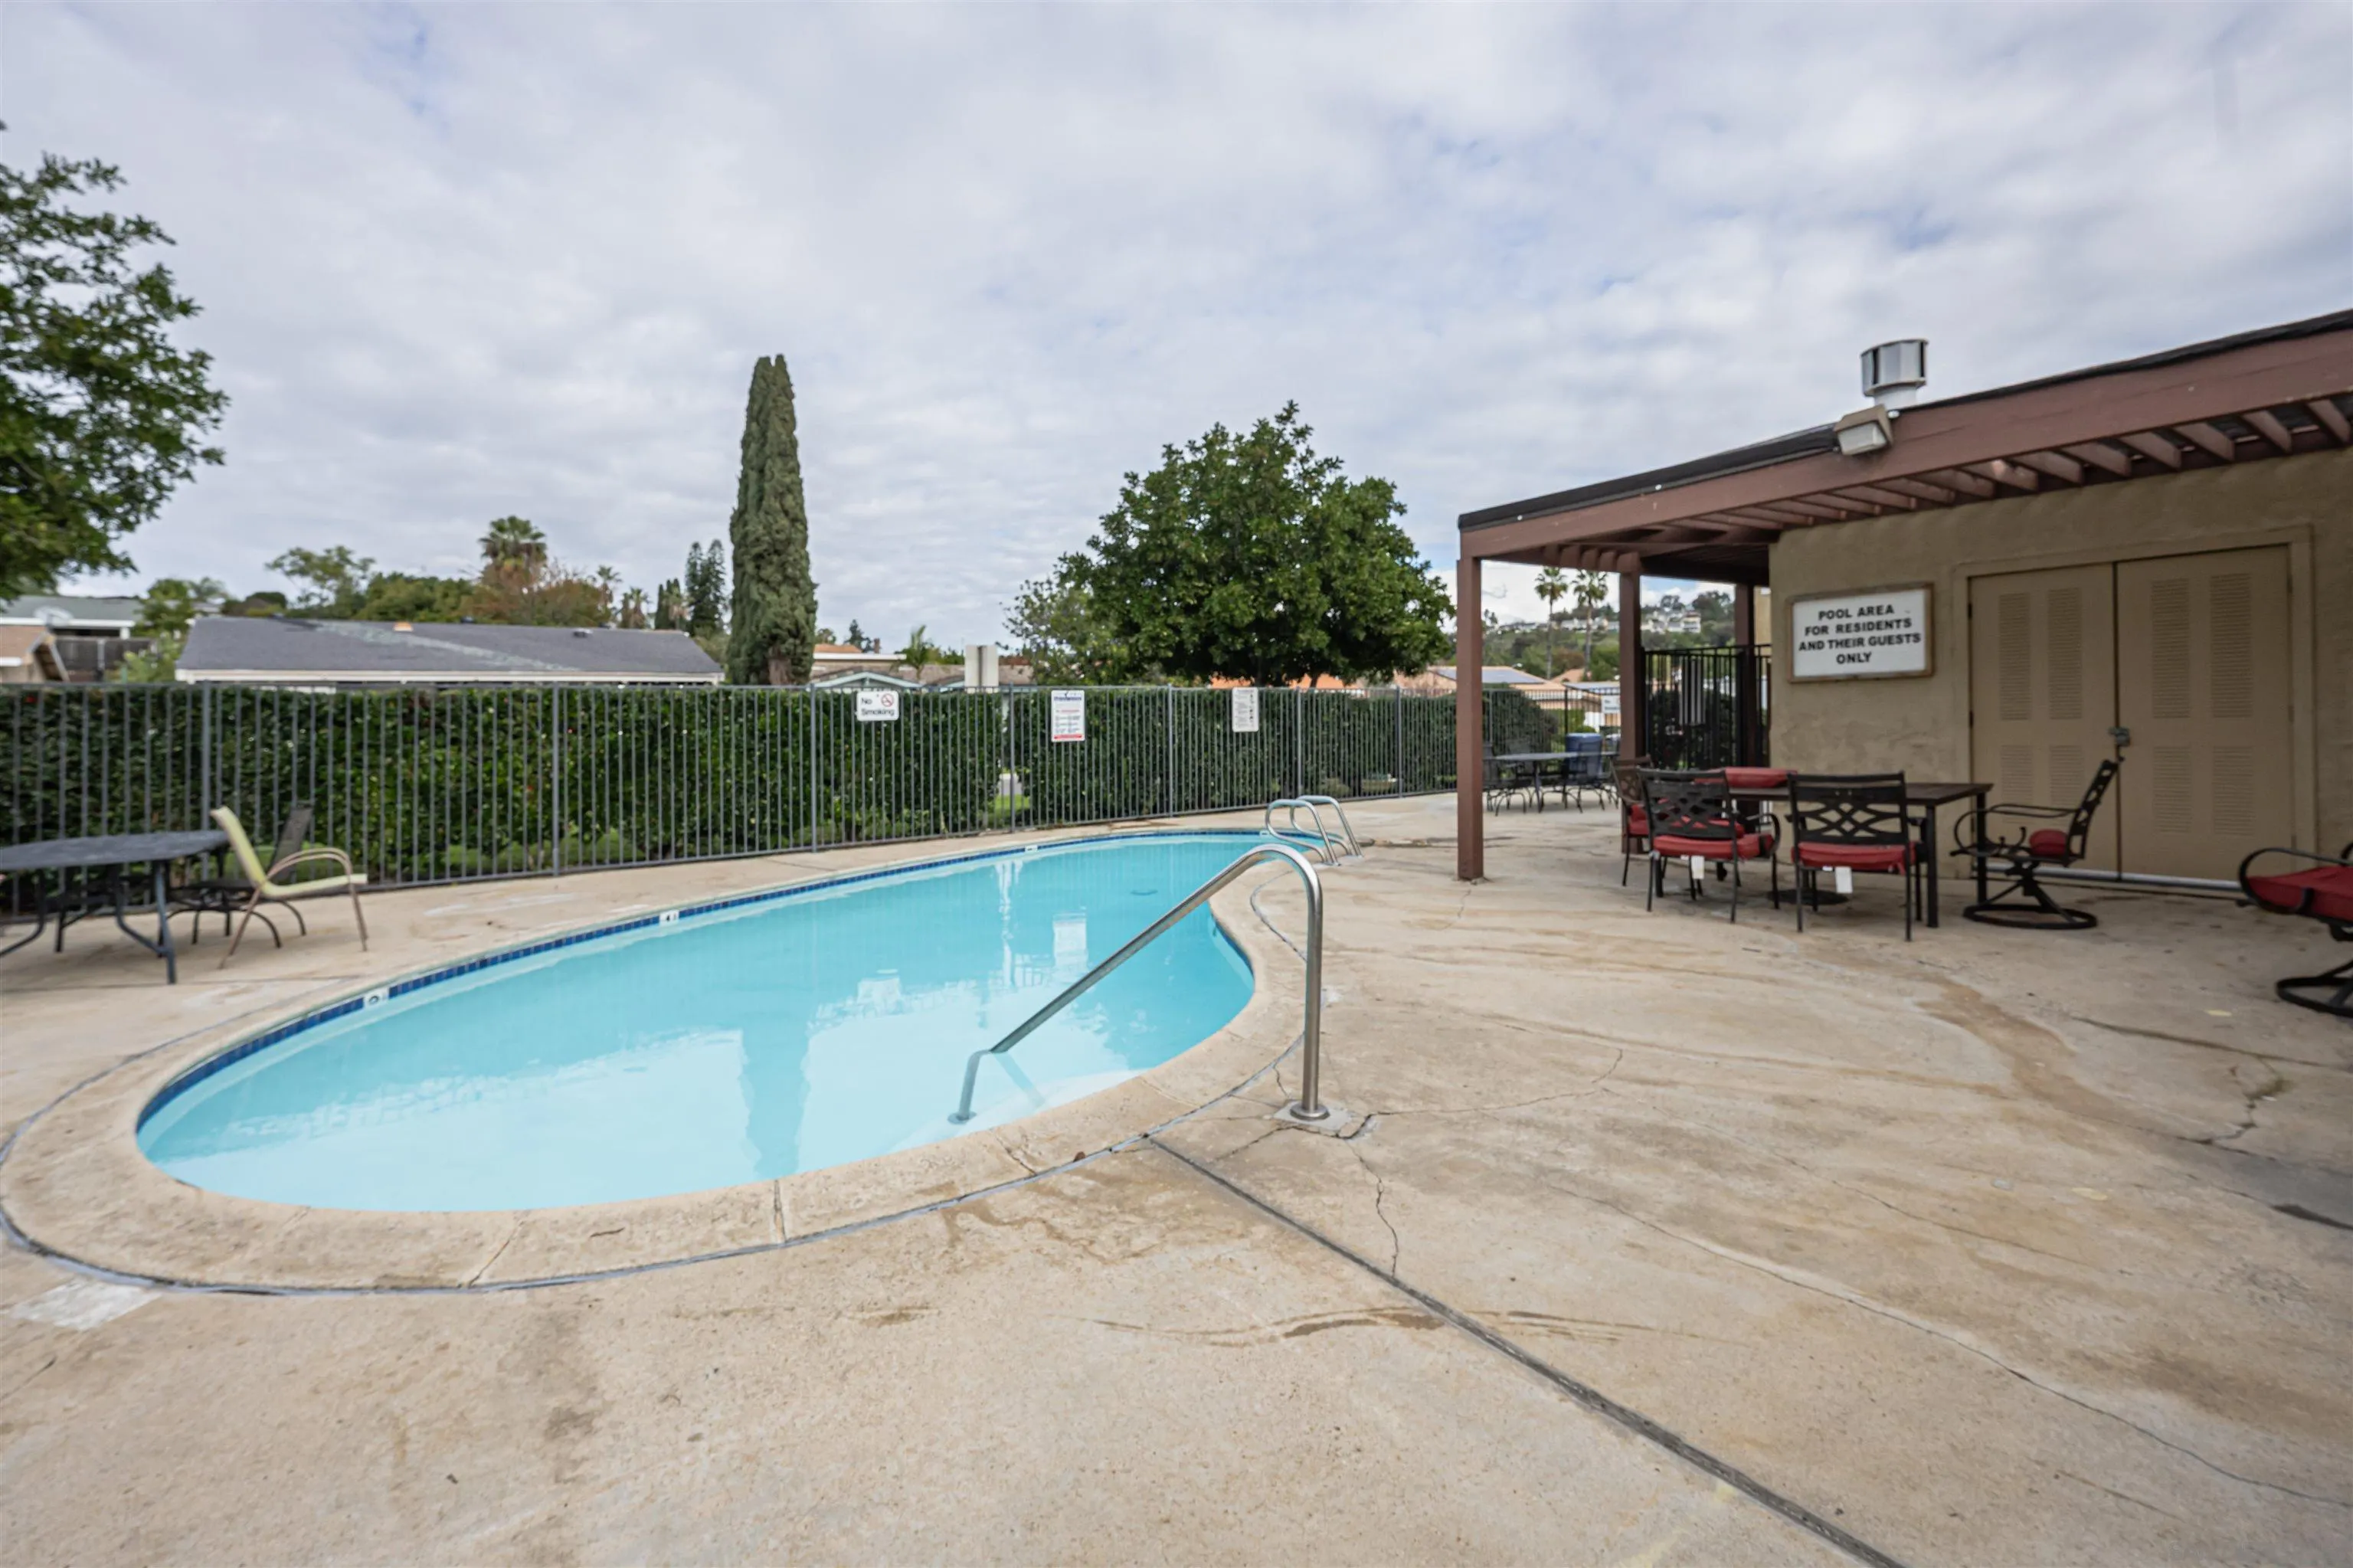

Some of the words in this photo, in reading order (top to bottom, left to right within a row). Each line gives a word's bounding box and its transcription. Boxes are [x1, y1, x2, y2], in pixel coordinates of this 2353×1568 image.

[1818, 608, 1852, 620] POOL
[1857, 604, 1894, 617] AREA
[1805, 626, 1828, 637] FOR
[1835, 617, 1912, 634] RESIDENTS
[1798, 640, 1824, 651] AND
[1828, 637, 1864, 649] THEIR
[1868, 633, 1921, 647] GUESTS
[1836, 652, 1872, 665] ONLY
